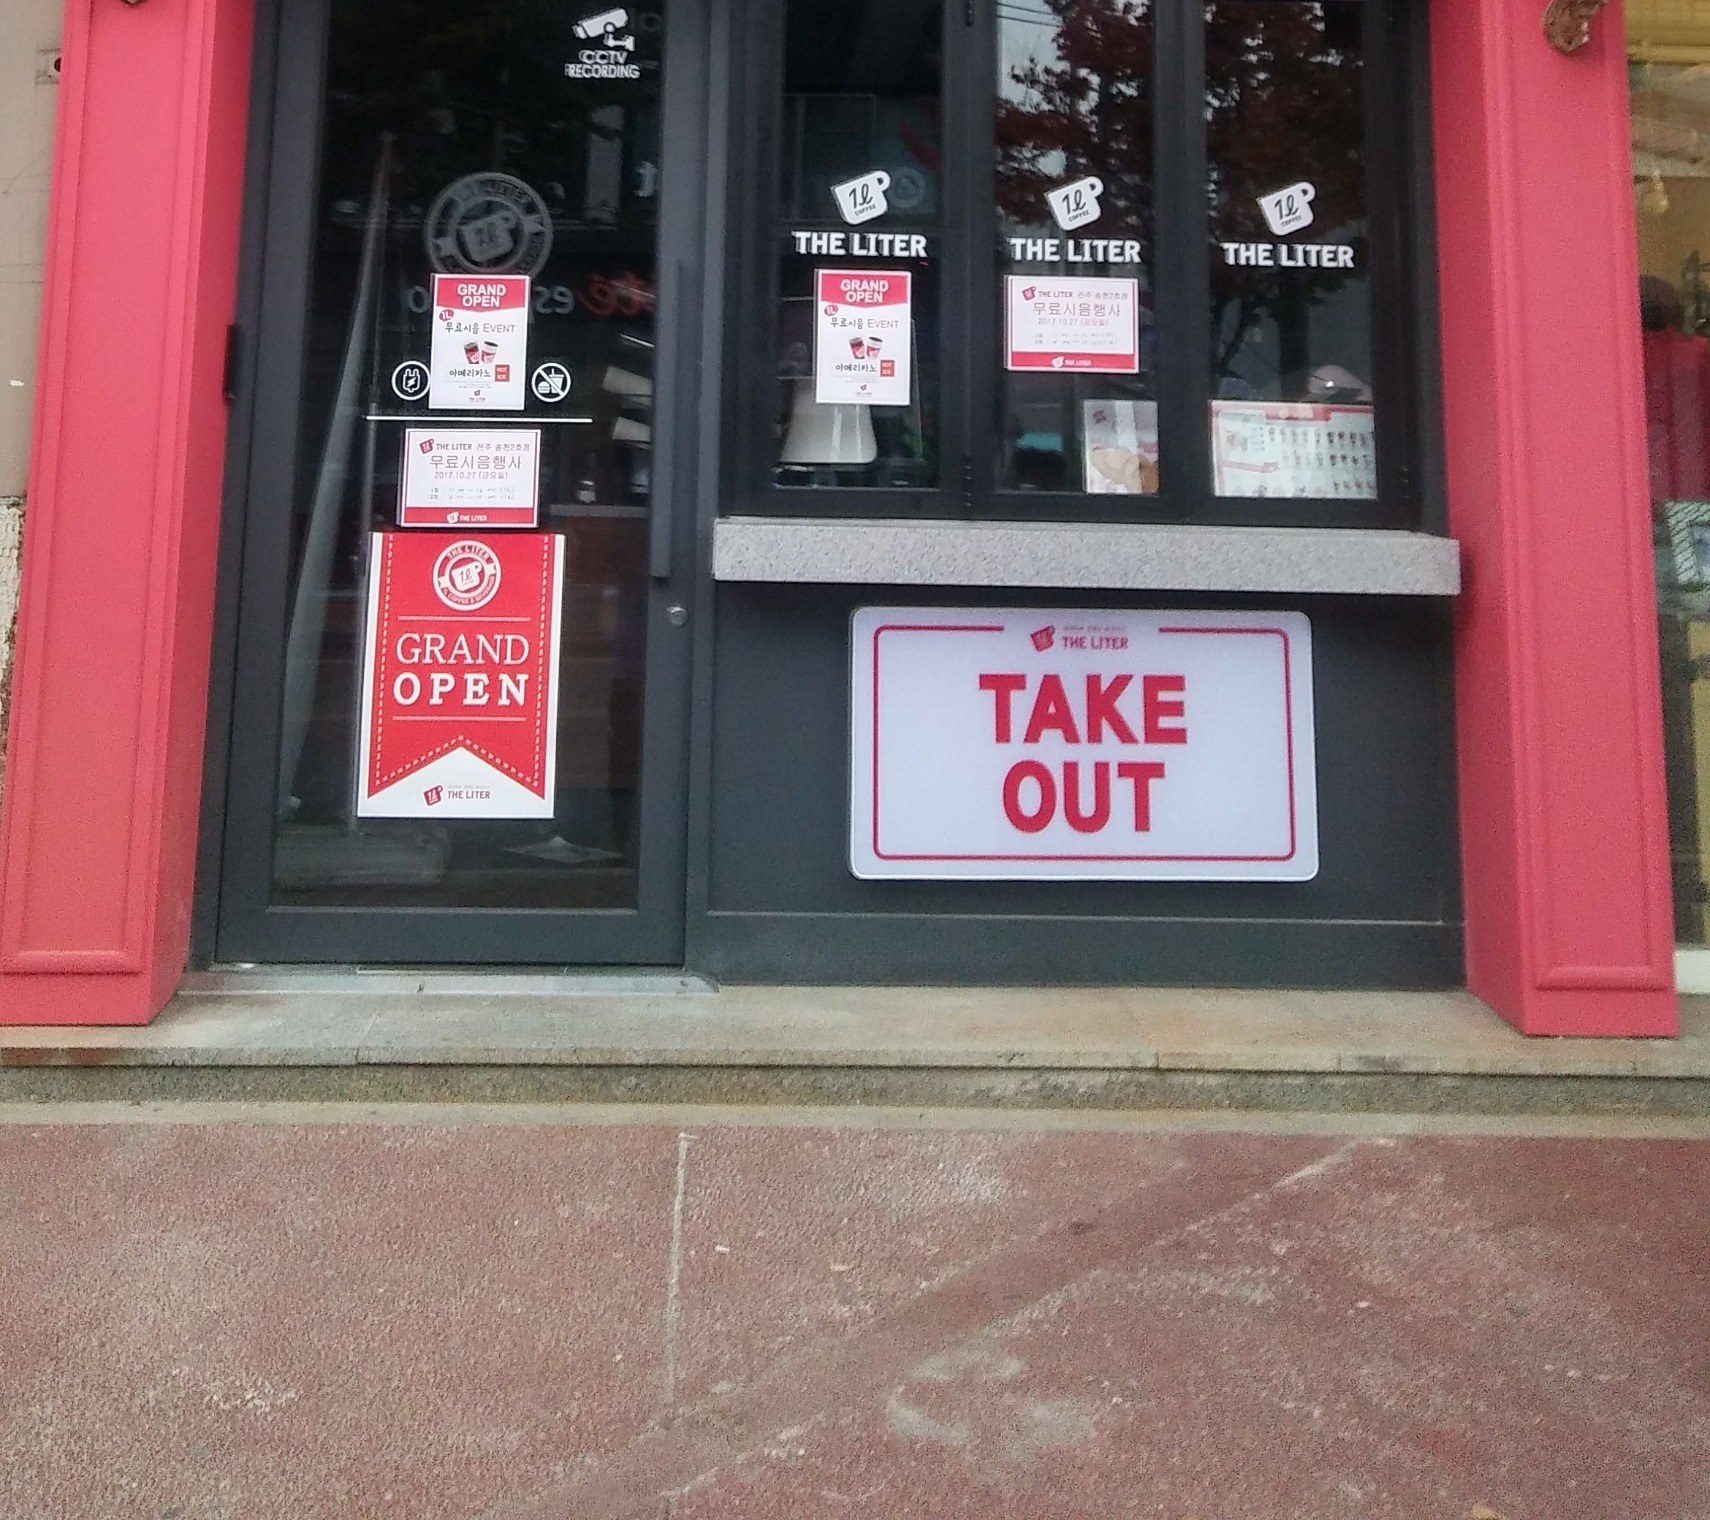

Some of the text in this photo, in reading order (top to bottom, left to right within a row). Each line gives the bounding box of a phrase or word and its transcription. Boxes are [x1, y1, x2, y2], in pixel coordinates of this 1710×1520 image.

[578, 49, 629, 65] CCTV
[564, 63, 641, 79] RECORDING
[854, 203, 877, 217] COFFEE
[1068, 209, 1090, 223] COFFEE
[791, 231, 928, 259] THE LITER
[1008, 237, 1142, 264] THE LITER
[1221, 242, 1356, 269] THE LITER
[456, 283, 507, 297] GRAND
[840, 278, 889, 292] GRAND
[845, 291, 884, 303] OPEN
[1038, 290, 1051, 298] THE
[1053, 290, 1074, 298] LITER
[462, 295, 500, 308] OPEN
[1033, 302, 1121, 318] 무료시음행사
[445, 321, 480, 335] 무료시음
[449, 368, 492, 378] 아메리카노
[835, 362, 878, 373] 아메리카노
[436, 443, 450, 451] THE
[451, 443, 472, 451] LITER
[429, 454, 522, 470] 무료시음행사
[434, 471, 476, 480] 2017.10.27
[396, 632, 530, 665] GRAND
[1062, 636, 1129, 650] THE LITER
[393, 672, 530, 706] OPEN
[978, 673, 1188, 745] TAKE
[447, 790, 491, 800] THE LITER
[1002, 759, 1167, 833] OUT
